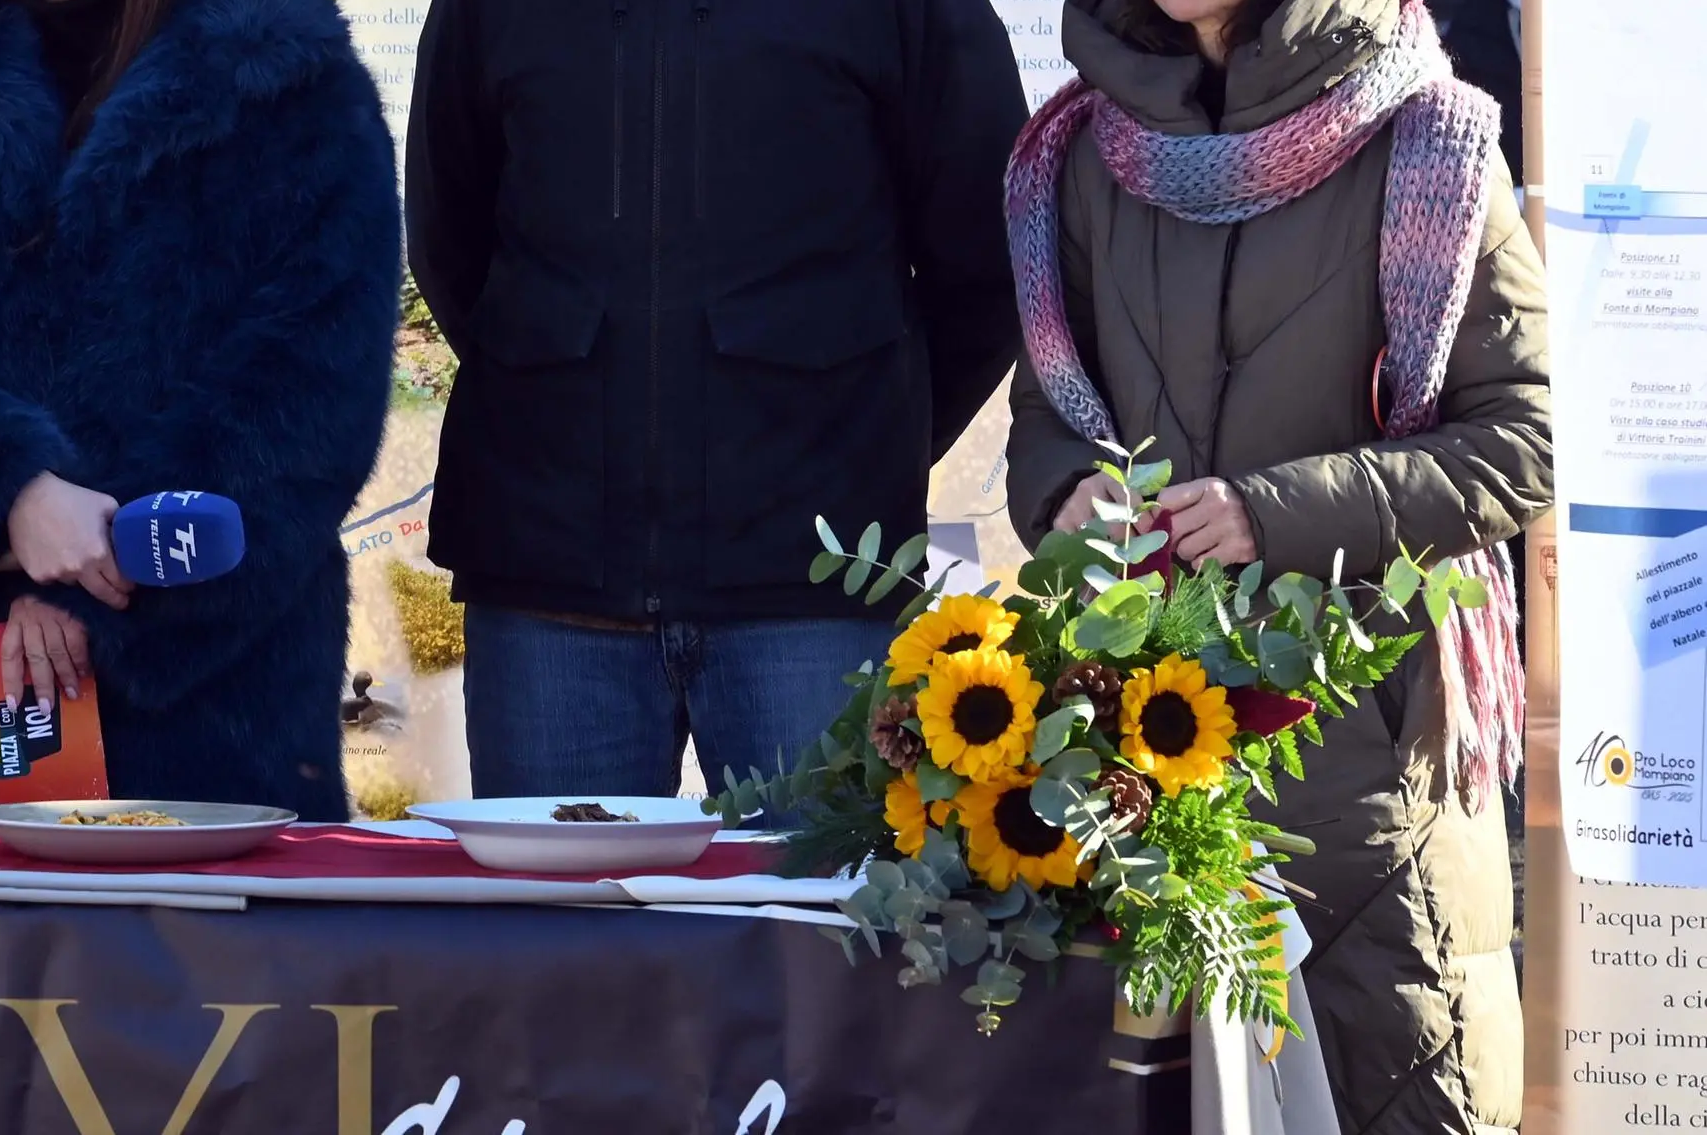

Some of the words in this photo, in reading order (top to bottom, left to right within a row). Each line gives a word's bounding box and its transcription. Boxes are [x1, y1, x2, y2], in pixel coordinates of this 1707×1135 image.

[1621, 252, 1665, 263] Posizione
[150, 518, 165, 580] TELETUTTO
[1636, 551, 1698, 581] Allestimento
[1646, 590, 1662, 604] nel
[1663, 576, 1703, 600] piazzale
[1673, 629, 1706, 647] Natale
[1, 734, 21, 776] PIAZZA
[1635, 751, 1657, 767] Pro
[1661, 753, 1695, 769] Loco
[1635, 767, 1695, 784] Mompiano
[1576, 819, 1693, 848] Girasolidarietà
[1579, 902, 1662, 935] l’acqua
[1592, 947, 1657, 967] tratto
[1666, 947, 1687, 968] di
[1564, 1028, 1601, 1050] per
[1610, 1028, 1645, 1053] poi
[1573, 1062, 1646, 1086] chiuso
[1625, 1103, 1680, 1128] della
